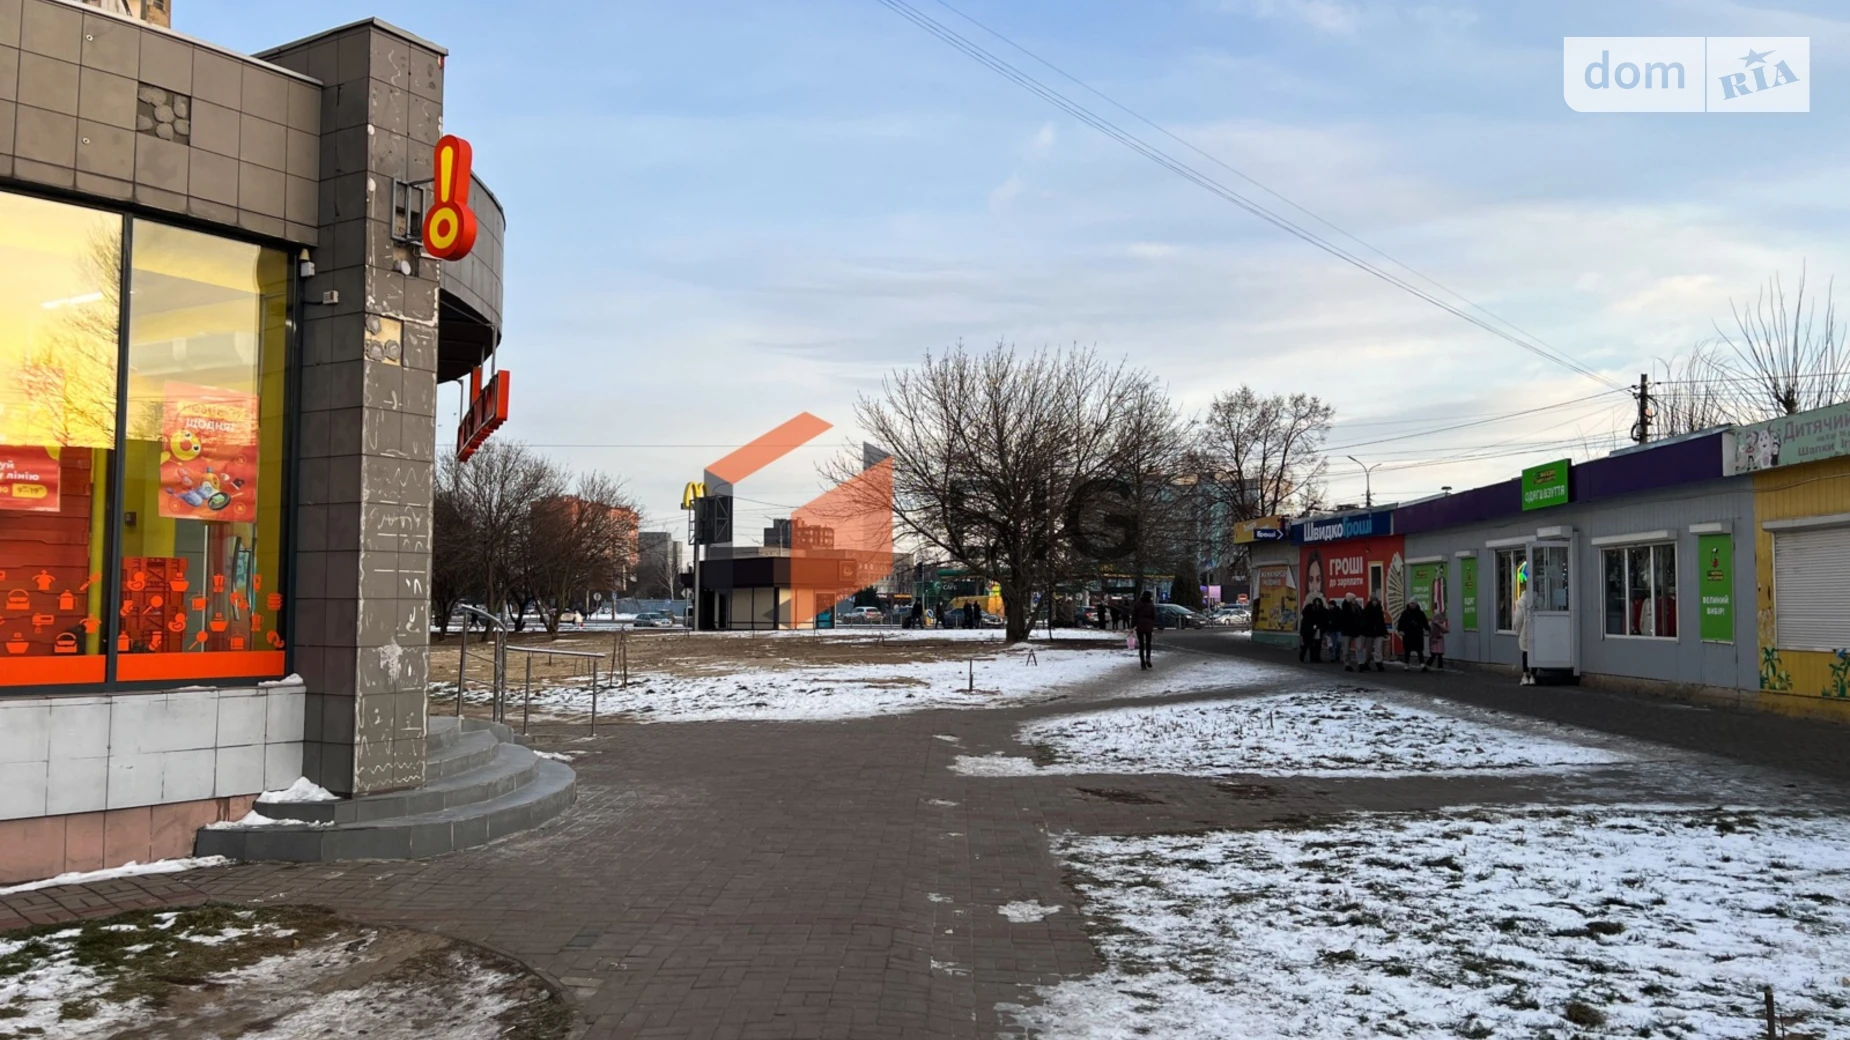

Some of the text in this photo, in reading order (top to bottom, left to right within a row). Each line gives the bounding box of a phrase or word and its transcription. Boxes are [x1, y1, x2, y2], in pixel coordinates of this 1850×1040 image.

[1798, 442, 1835, 456] Шапки
[1329, 556, 1363, 576] ГРОШІ
[1337, 577, 1363, 588] зарплати
[1702, 595, 1729, 604] ВЕЛИКИЙ
